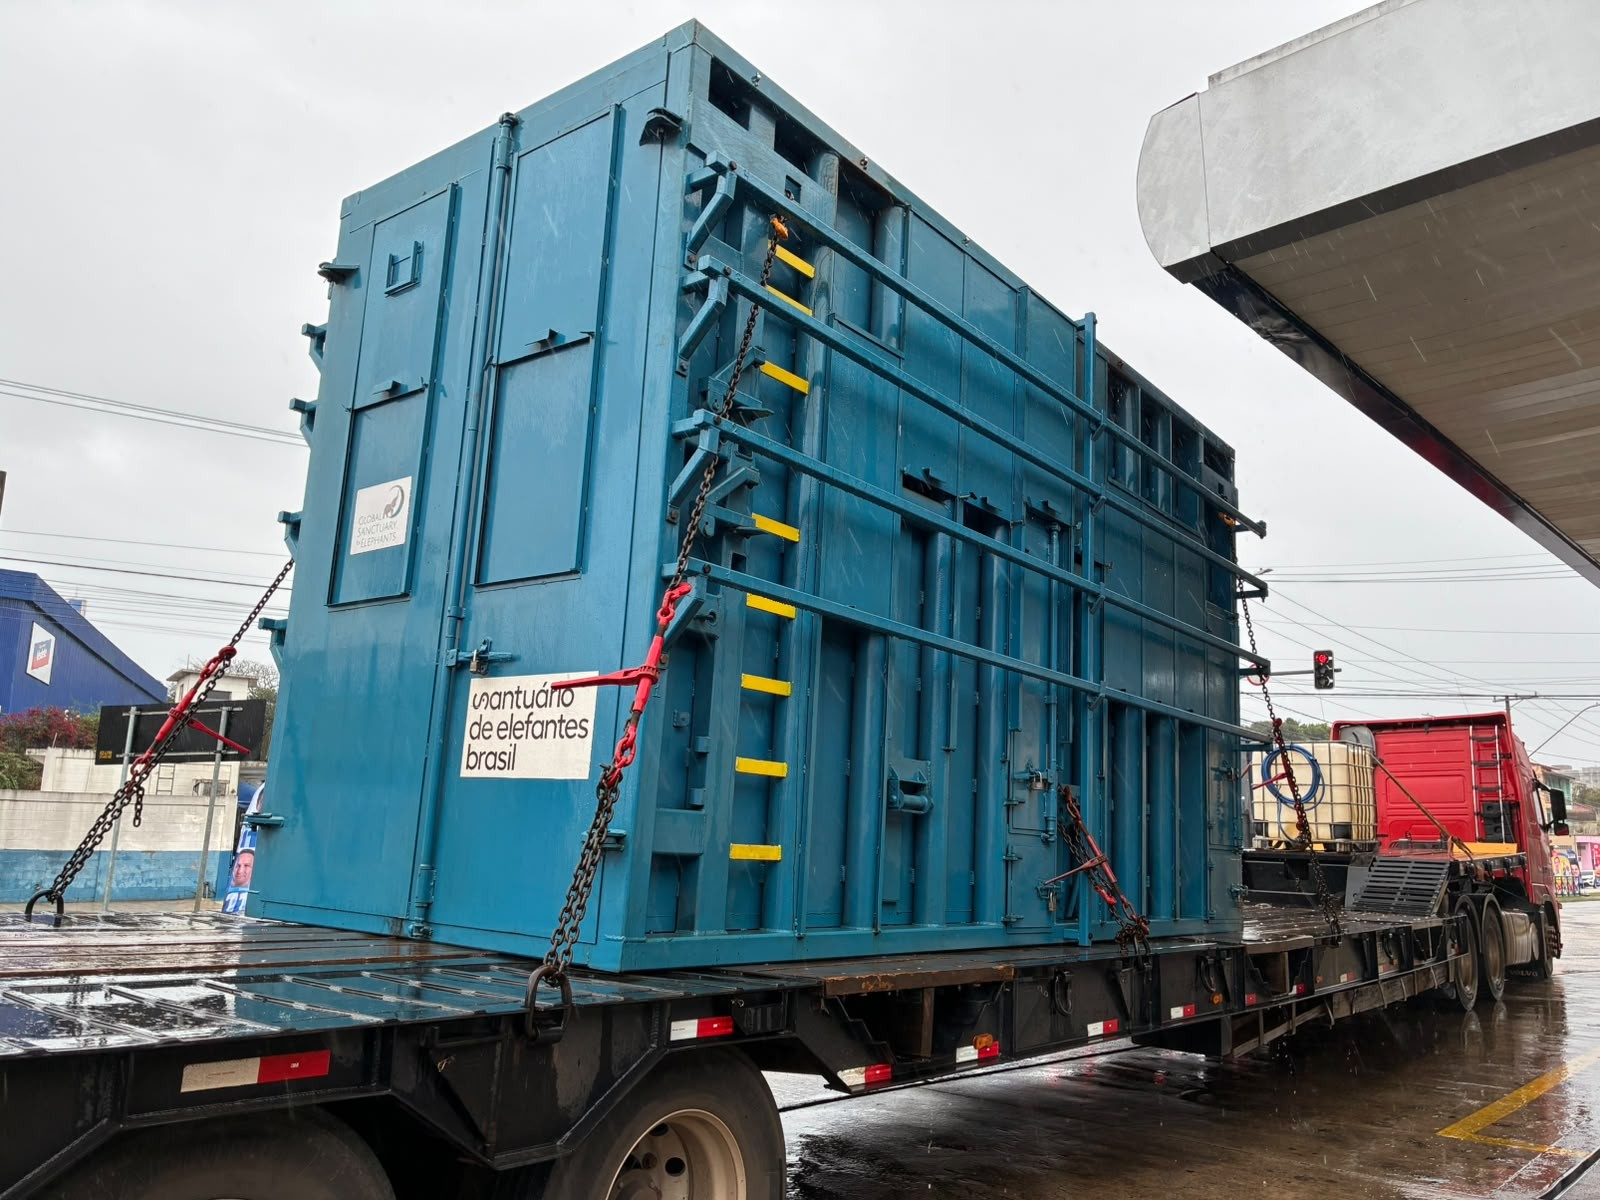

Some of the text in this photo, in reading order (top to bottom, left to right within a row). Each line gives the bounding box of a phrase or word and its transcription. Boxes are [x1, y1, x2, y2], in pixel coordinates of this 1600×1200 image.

[358, 513, 382, 526] GLOBAL
[357, 520, 398, 538] SANCTUARY
[360, 532, 397, 548] ELEPHANTS
[469, 712, 589, 740] de elefantes
[465, 743, 517, 771] brasil
